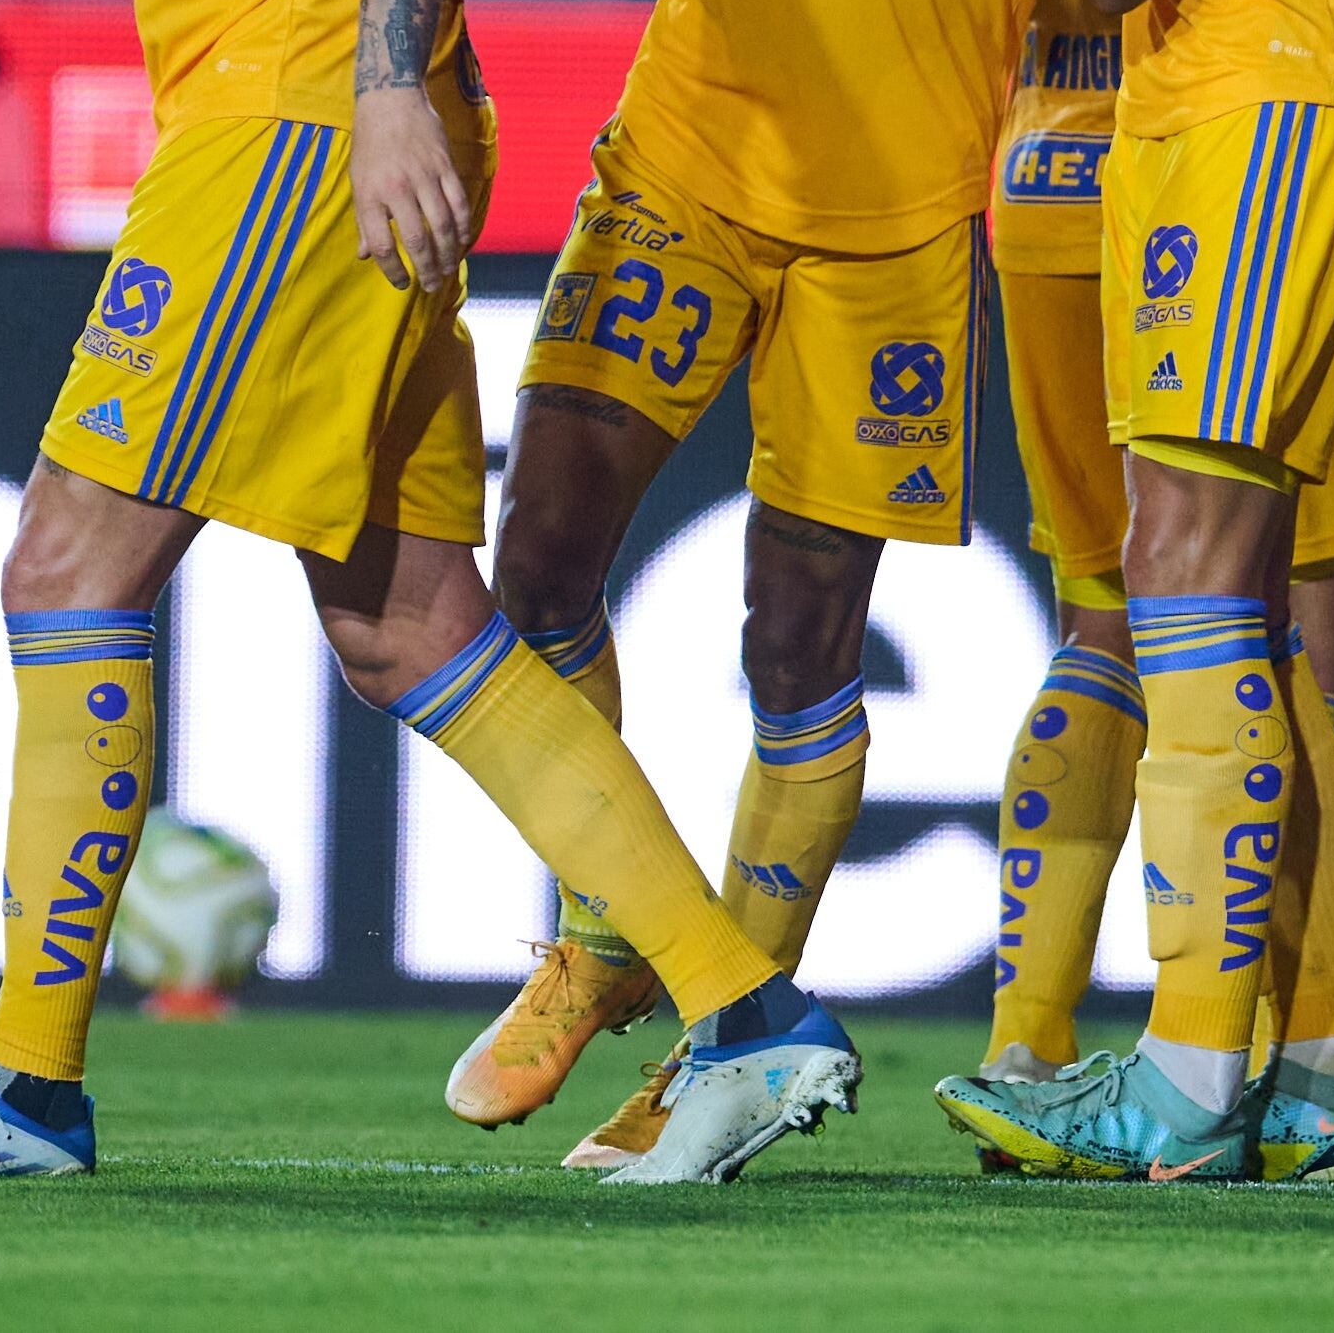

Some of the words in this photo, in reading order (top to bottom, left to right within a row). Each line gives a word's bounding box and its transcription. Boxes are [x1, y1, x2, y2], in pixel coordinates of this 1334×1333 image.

[581, 209, 671, 251] Vertua
[590, 258, 713, 388] 23
[105, 340, 154, 372] GAS
[1146, 375, 1183, 391] adidas
[76, 413, 129, 445] adidas
[900, 425, 949, 443] GAS
[886, 488, 946, 504] adidas
